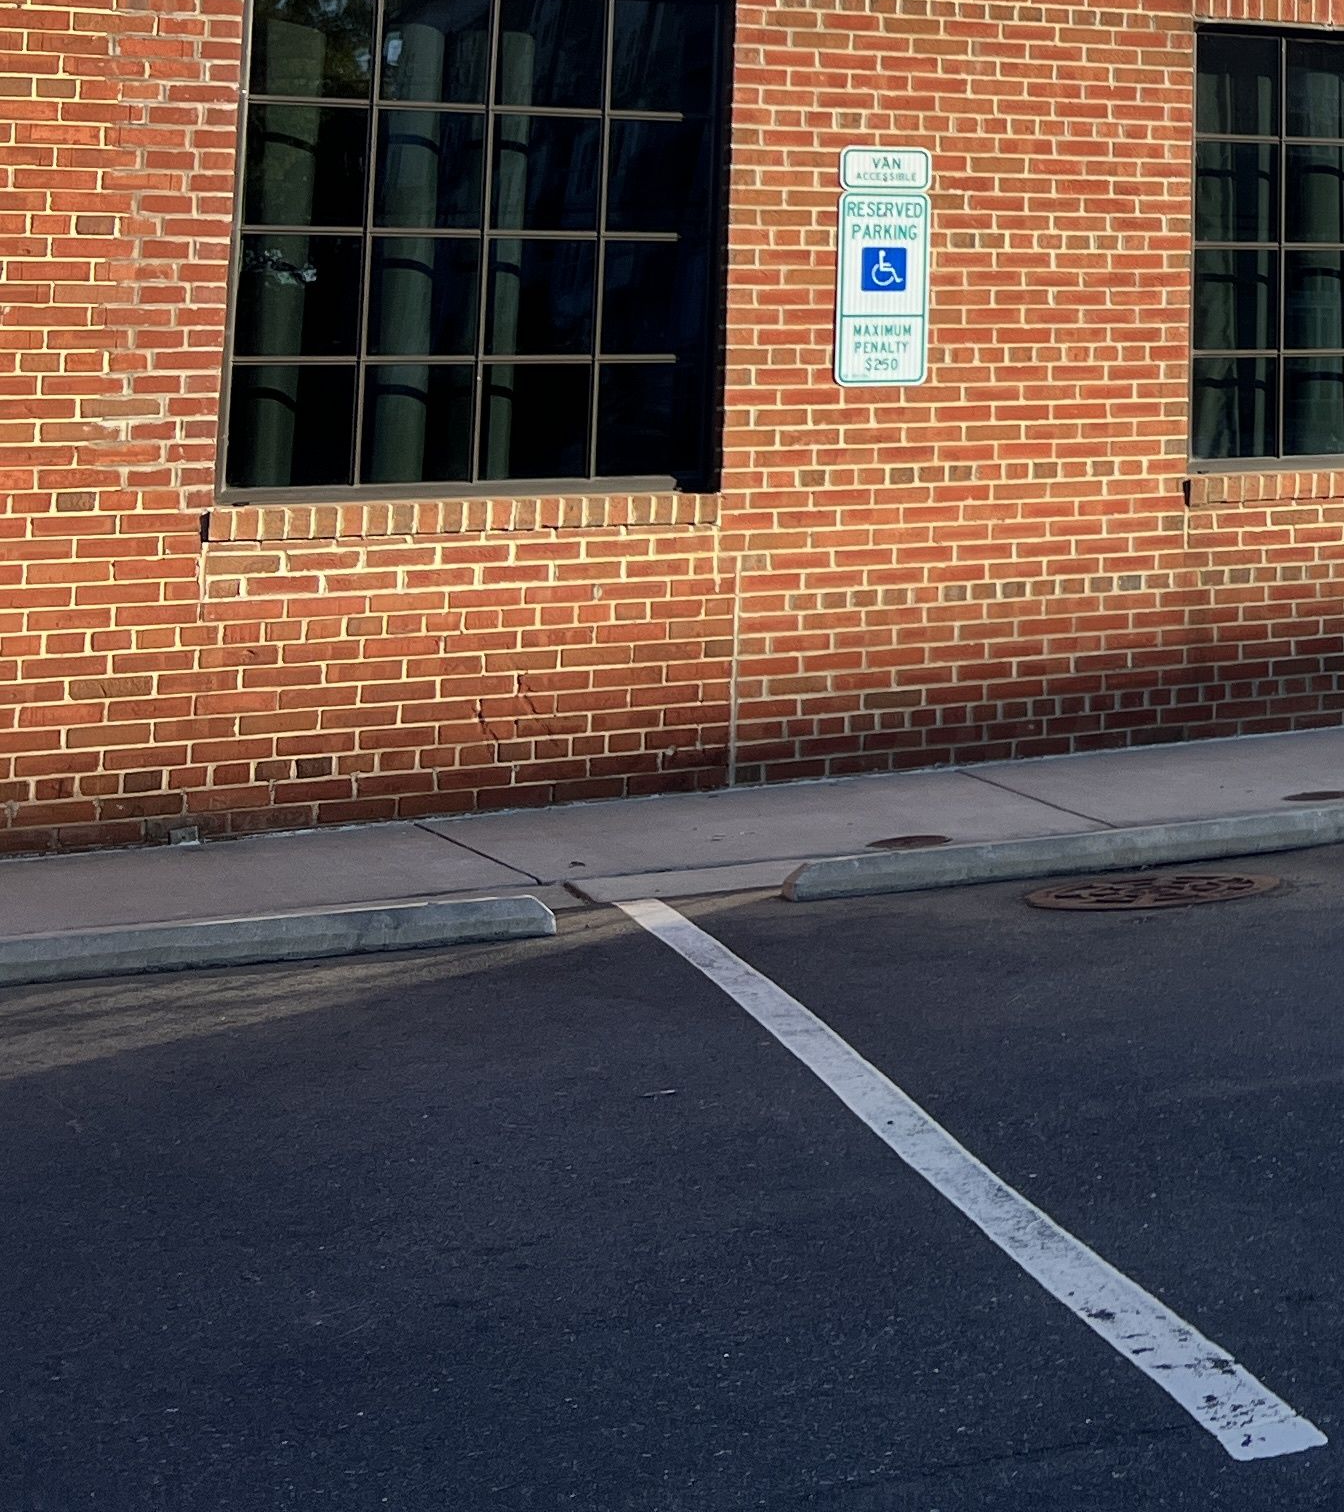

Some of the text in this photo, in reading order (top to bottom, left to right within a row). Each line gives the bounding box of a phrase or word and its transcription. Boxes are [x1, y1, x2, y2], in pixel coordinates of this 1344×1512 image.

[872, 157, 901, 170] VAN
[857, 172, 917, 182] ACCESSIBLE
[847, 201, 922, 218] RESERVED
[852, 224, 917, 240] PARKING
[854, 324, 912, 336] MAXIMUM
[855, 341, 909, 354] PENALTY
[864, 357, 898, 371] $250
